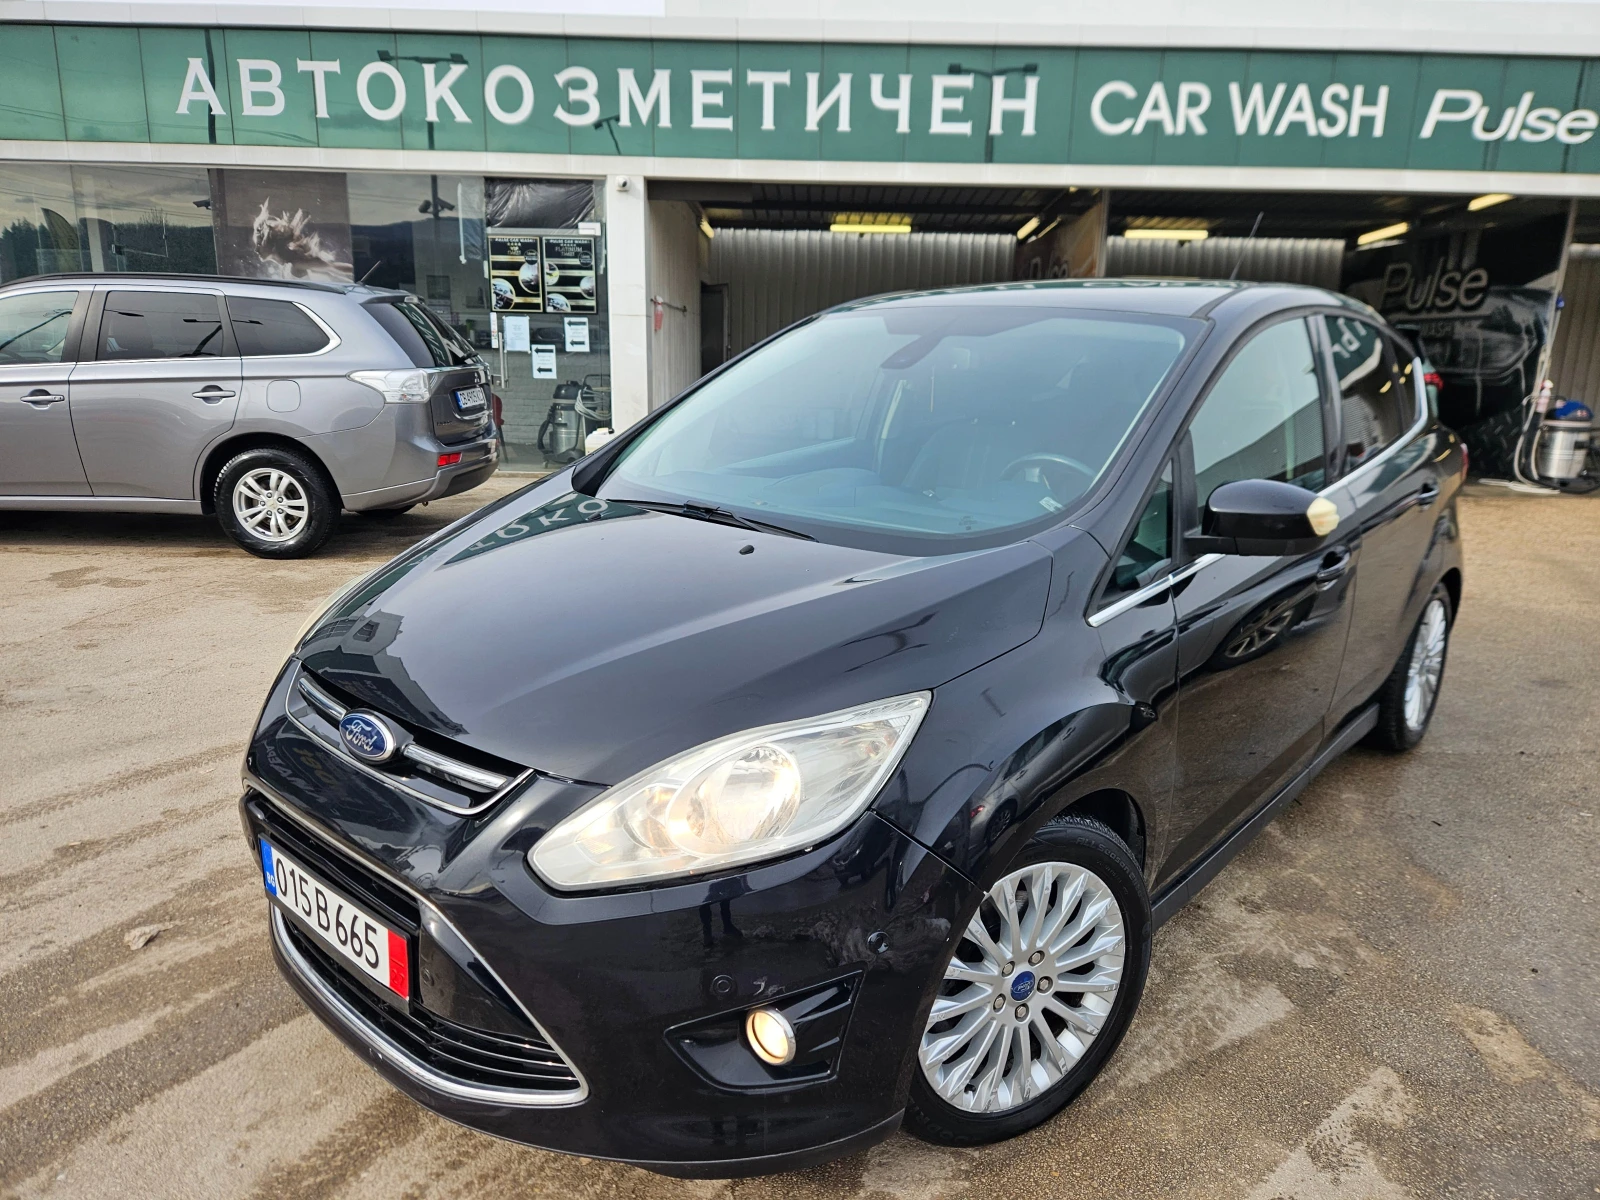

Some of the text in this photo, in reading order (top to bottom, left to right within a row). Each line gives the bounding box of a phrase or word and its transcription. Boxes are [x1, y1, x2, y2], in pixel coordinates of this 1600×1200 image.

[175, 57, 1040, 136] АВТОКОЗМЕТИЧЕН
[1090, 80, 1599, 145] CAR WASH Pulse
[1382, 256, 1488, 310] Pulse
[345, 719, 378, 752] Ford
[266, 871, 276, 887] BG
